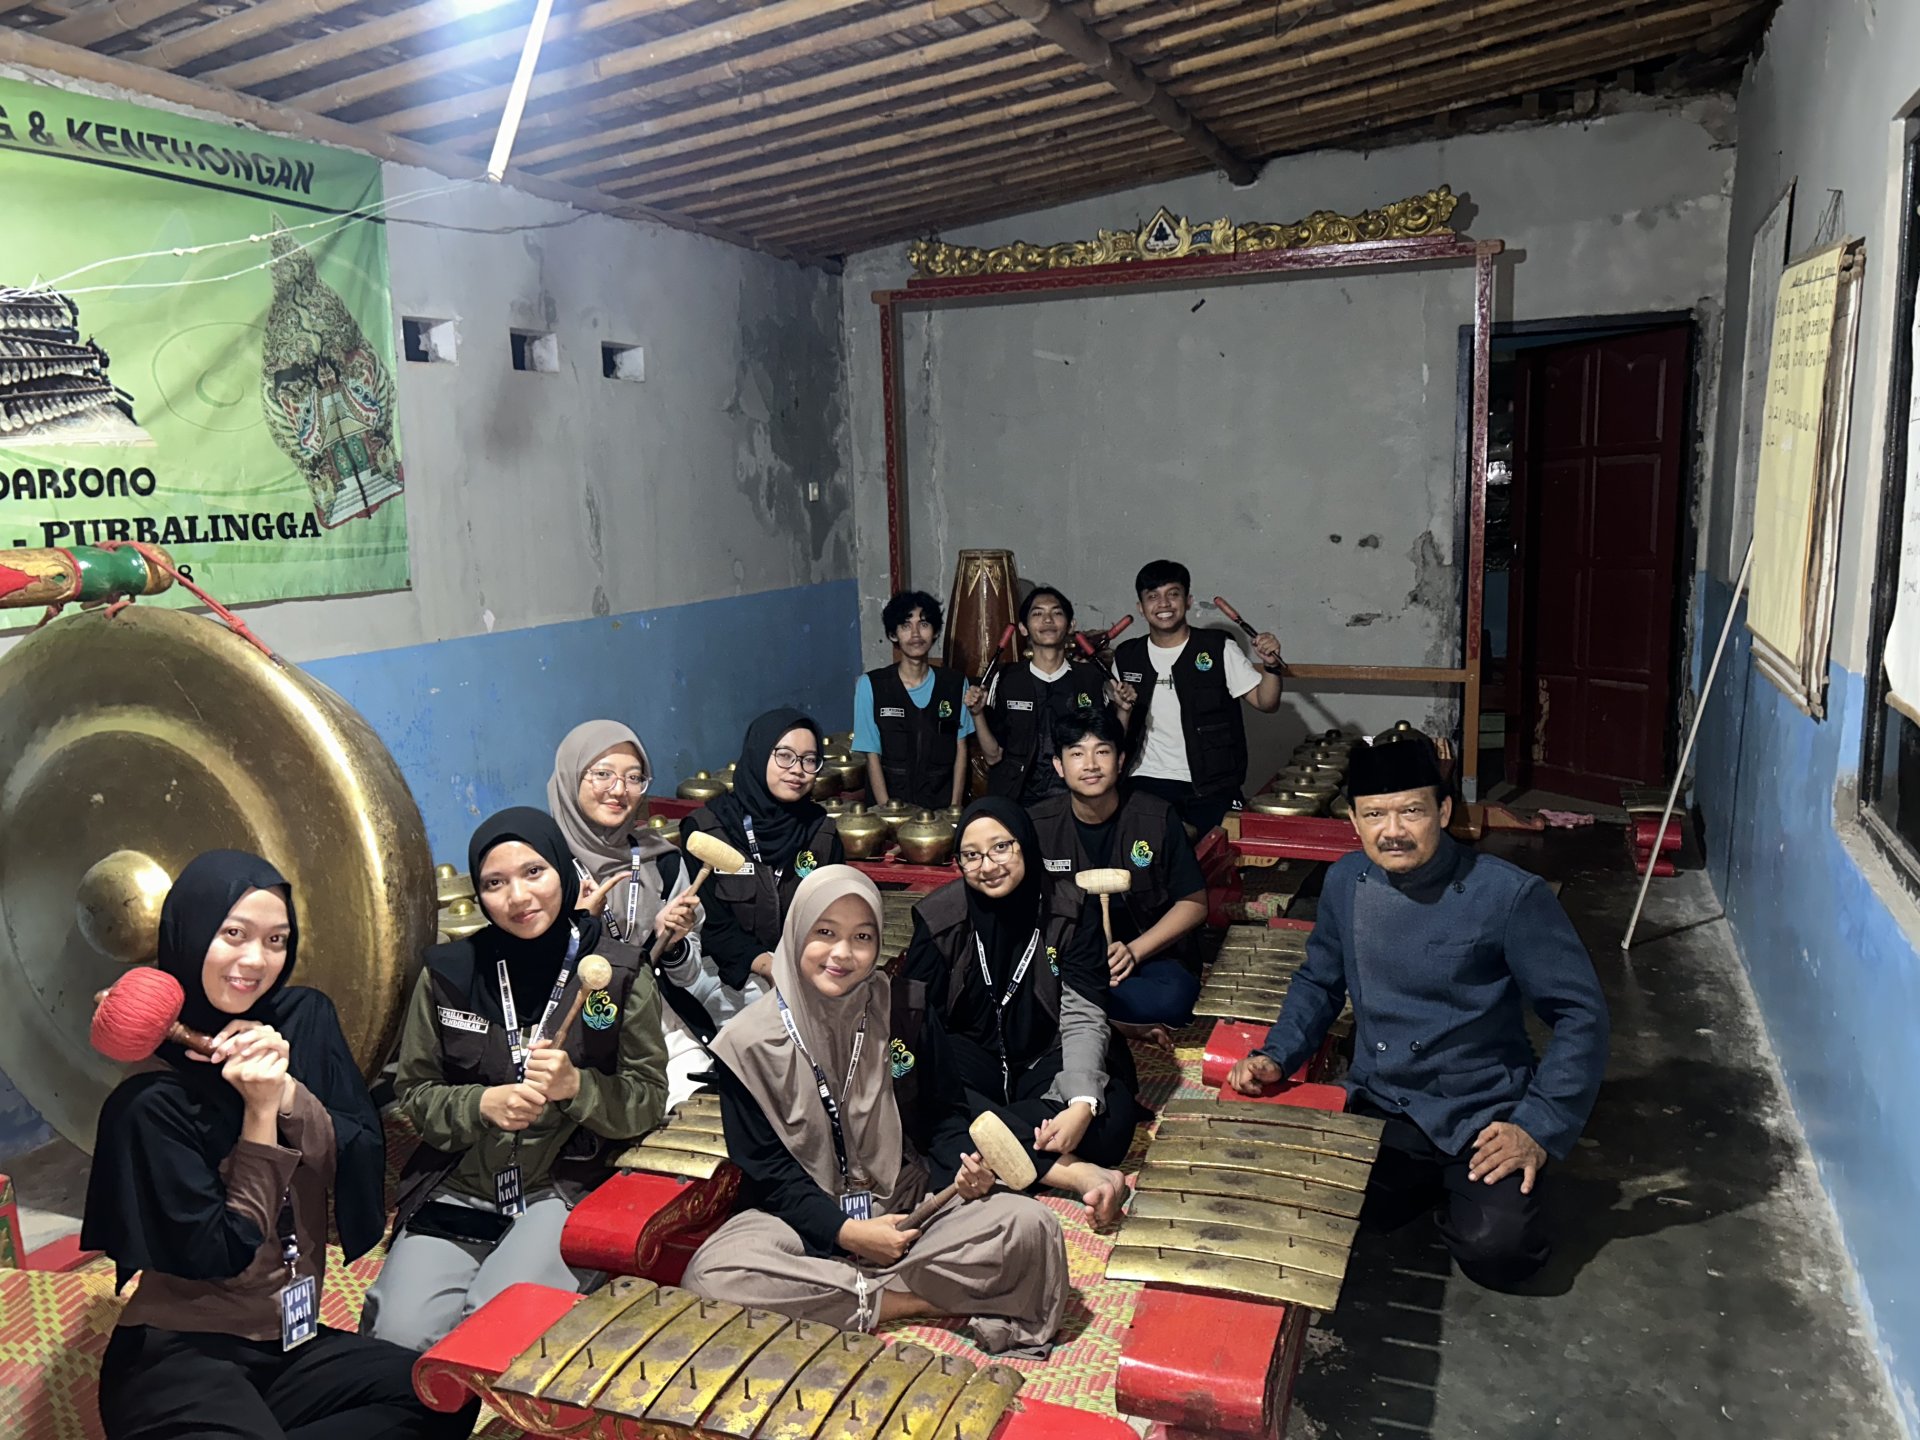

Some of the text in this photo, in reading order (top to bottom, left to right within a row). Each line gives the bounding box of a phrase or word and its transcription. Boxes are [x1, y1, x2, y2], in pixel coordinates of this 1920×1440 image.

[29, 111, 61, 147] &
[65, 117, 315, 195] KENTHONGAN
[39, 511, 322, 549] PURBALINGGA
